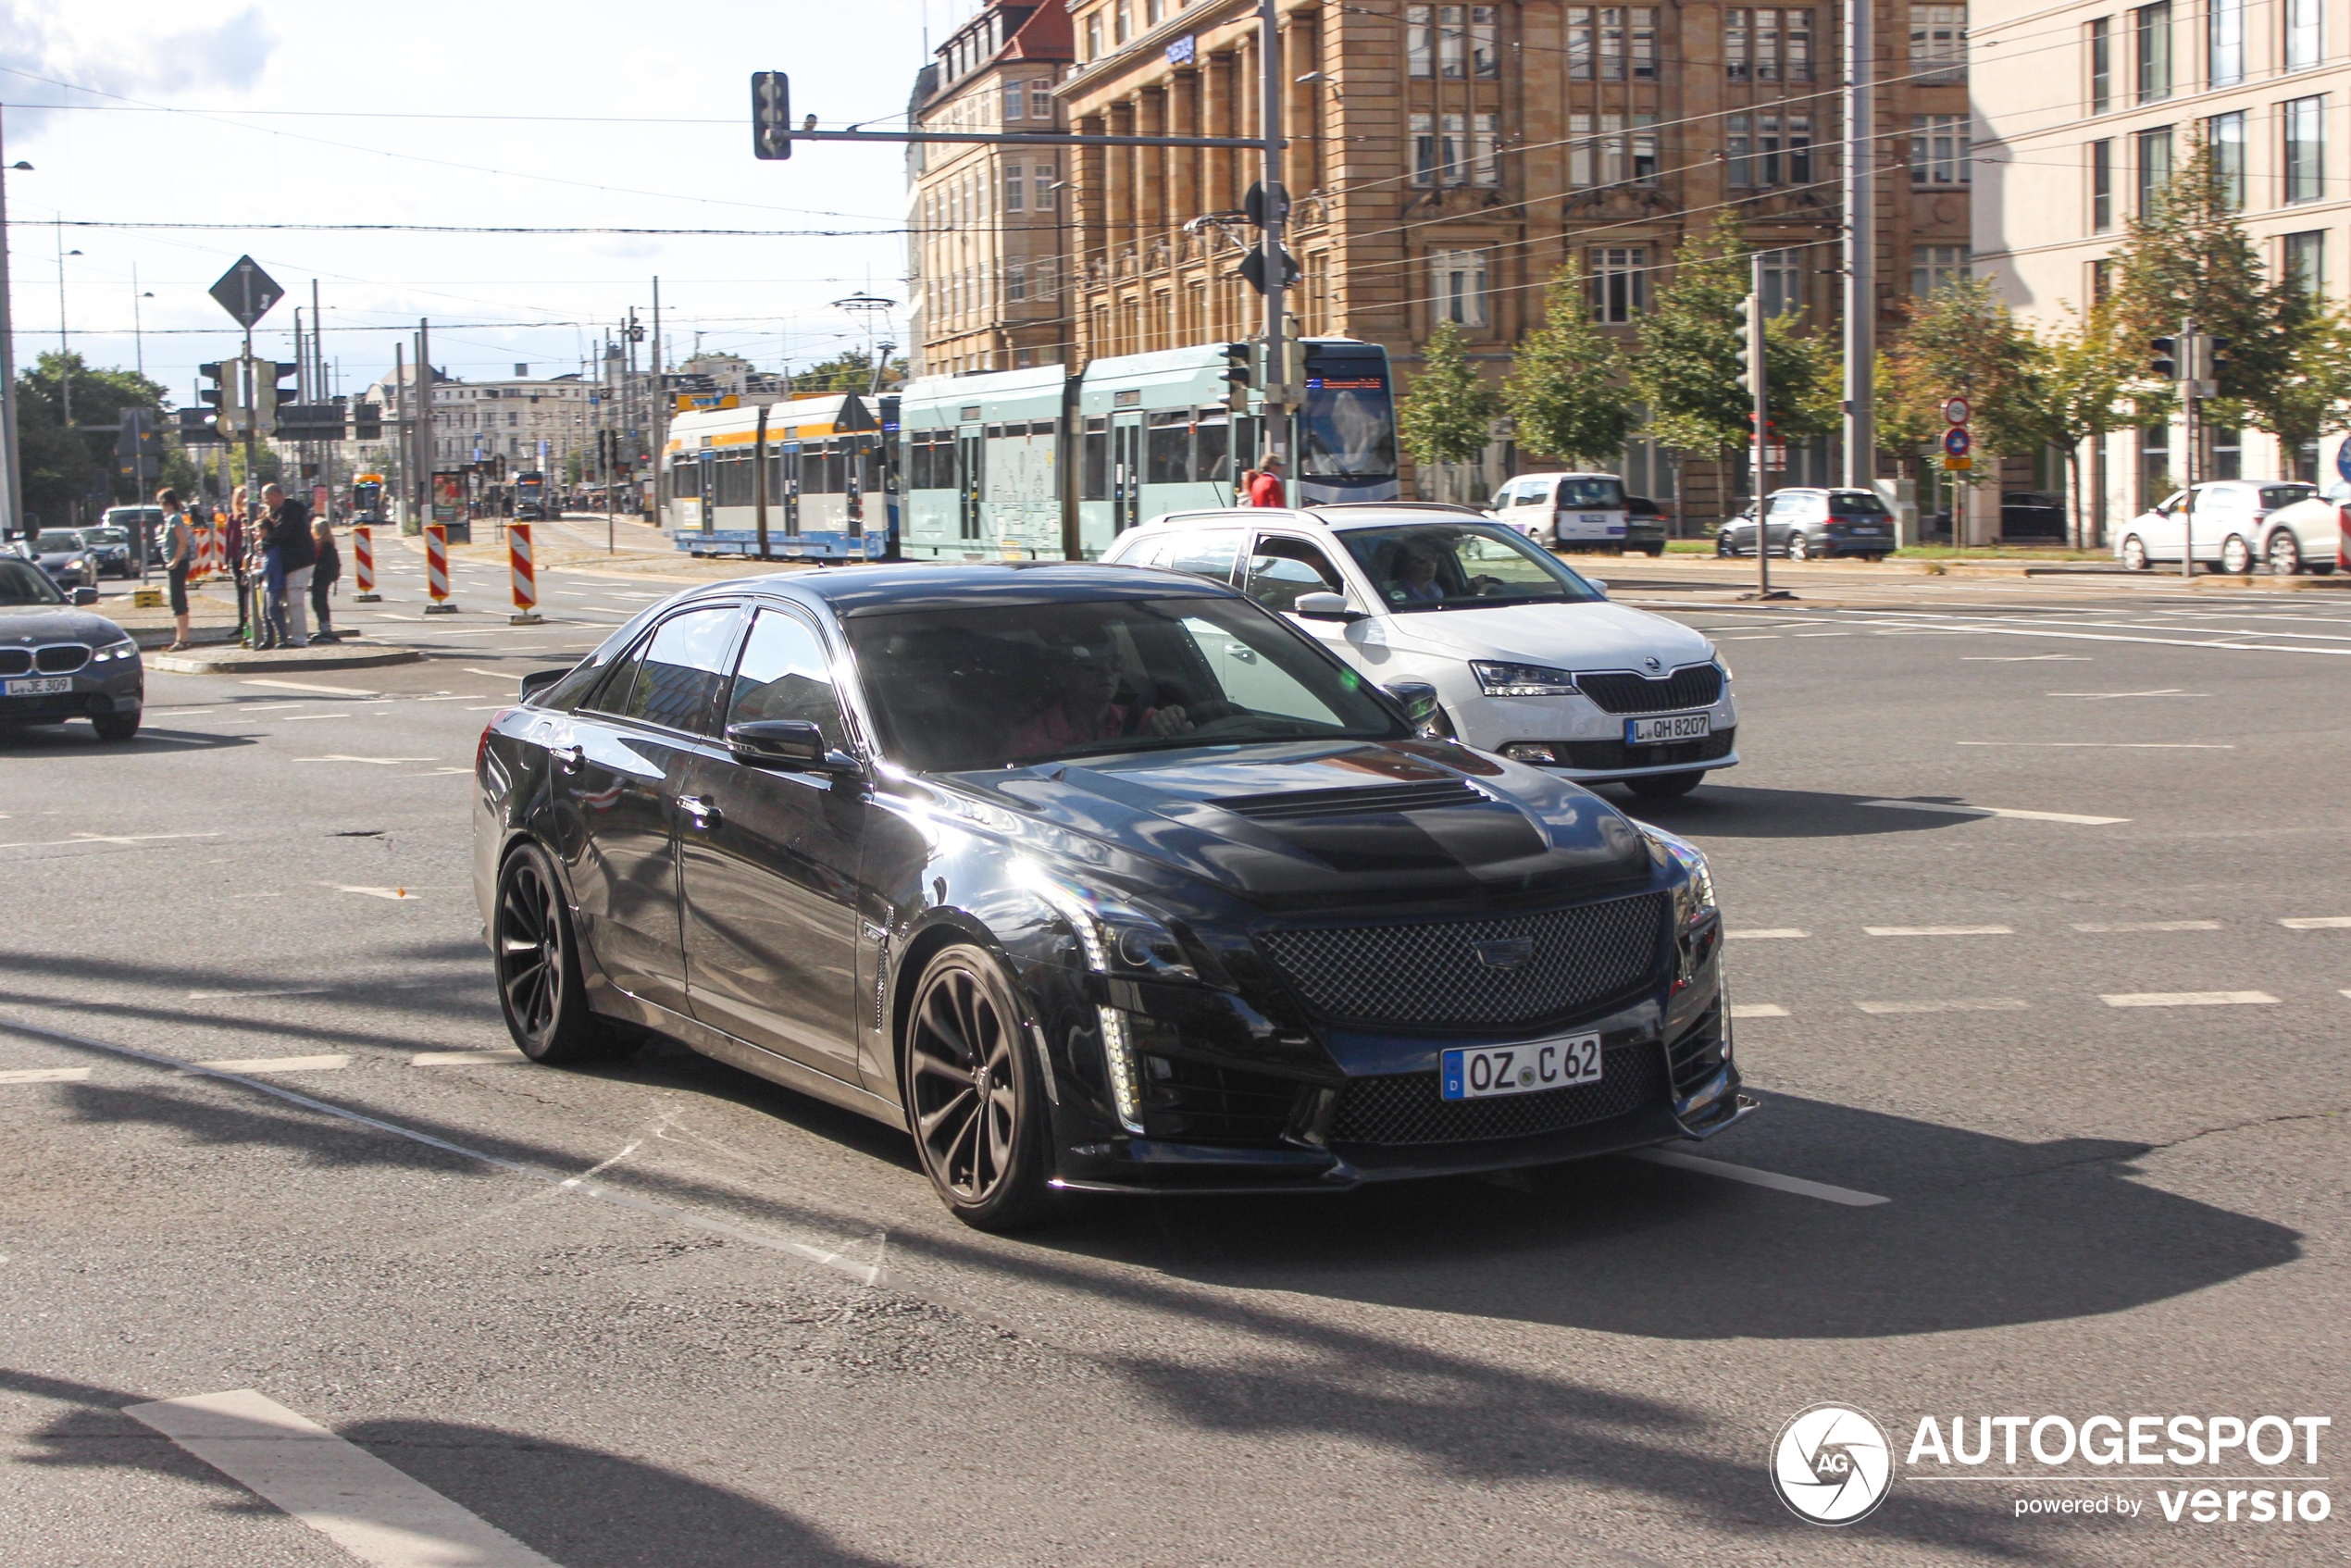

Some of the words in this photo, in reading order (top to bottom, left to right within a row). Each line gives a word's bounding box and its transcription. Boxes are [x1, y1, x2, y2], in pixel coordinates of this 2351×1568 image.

[9, 682, 19, 693] L
[27, 680, 43, 692] JE
[44, 678, 68, 691] 309
[1636, 723, 1645, 740] L
[1654, 720, 1672, 738] QH
[1674, 716, 1707, 737] 8207
[1470, 1052, 1516, 1091] OZ
[1538, 1046, 1557, 1083] C
[1563, 1039, 1598, 1079] 62
[1449, 1080, 1458, 1091] D
